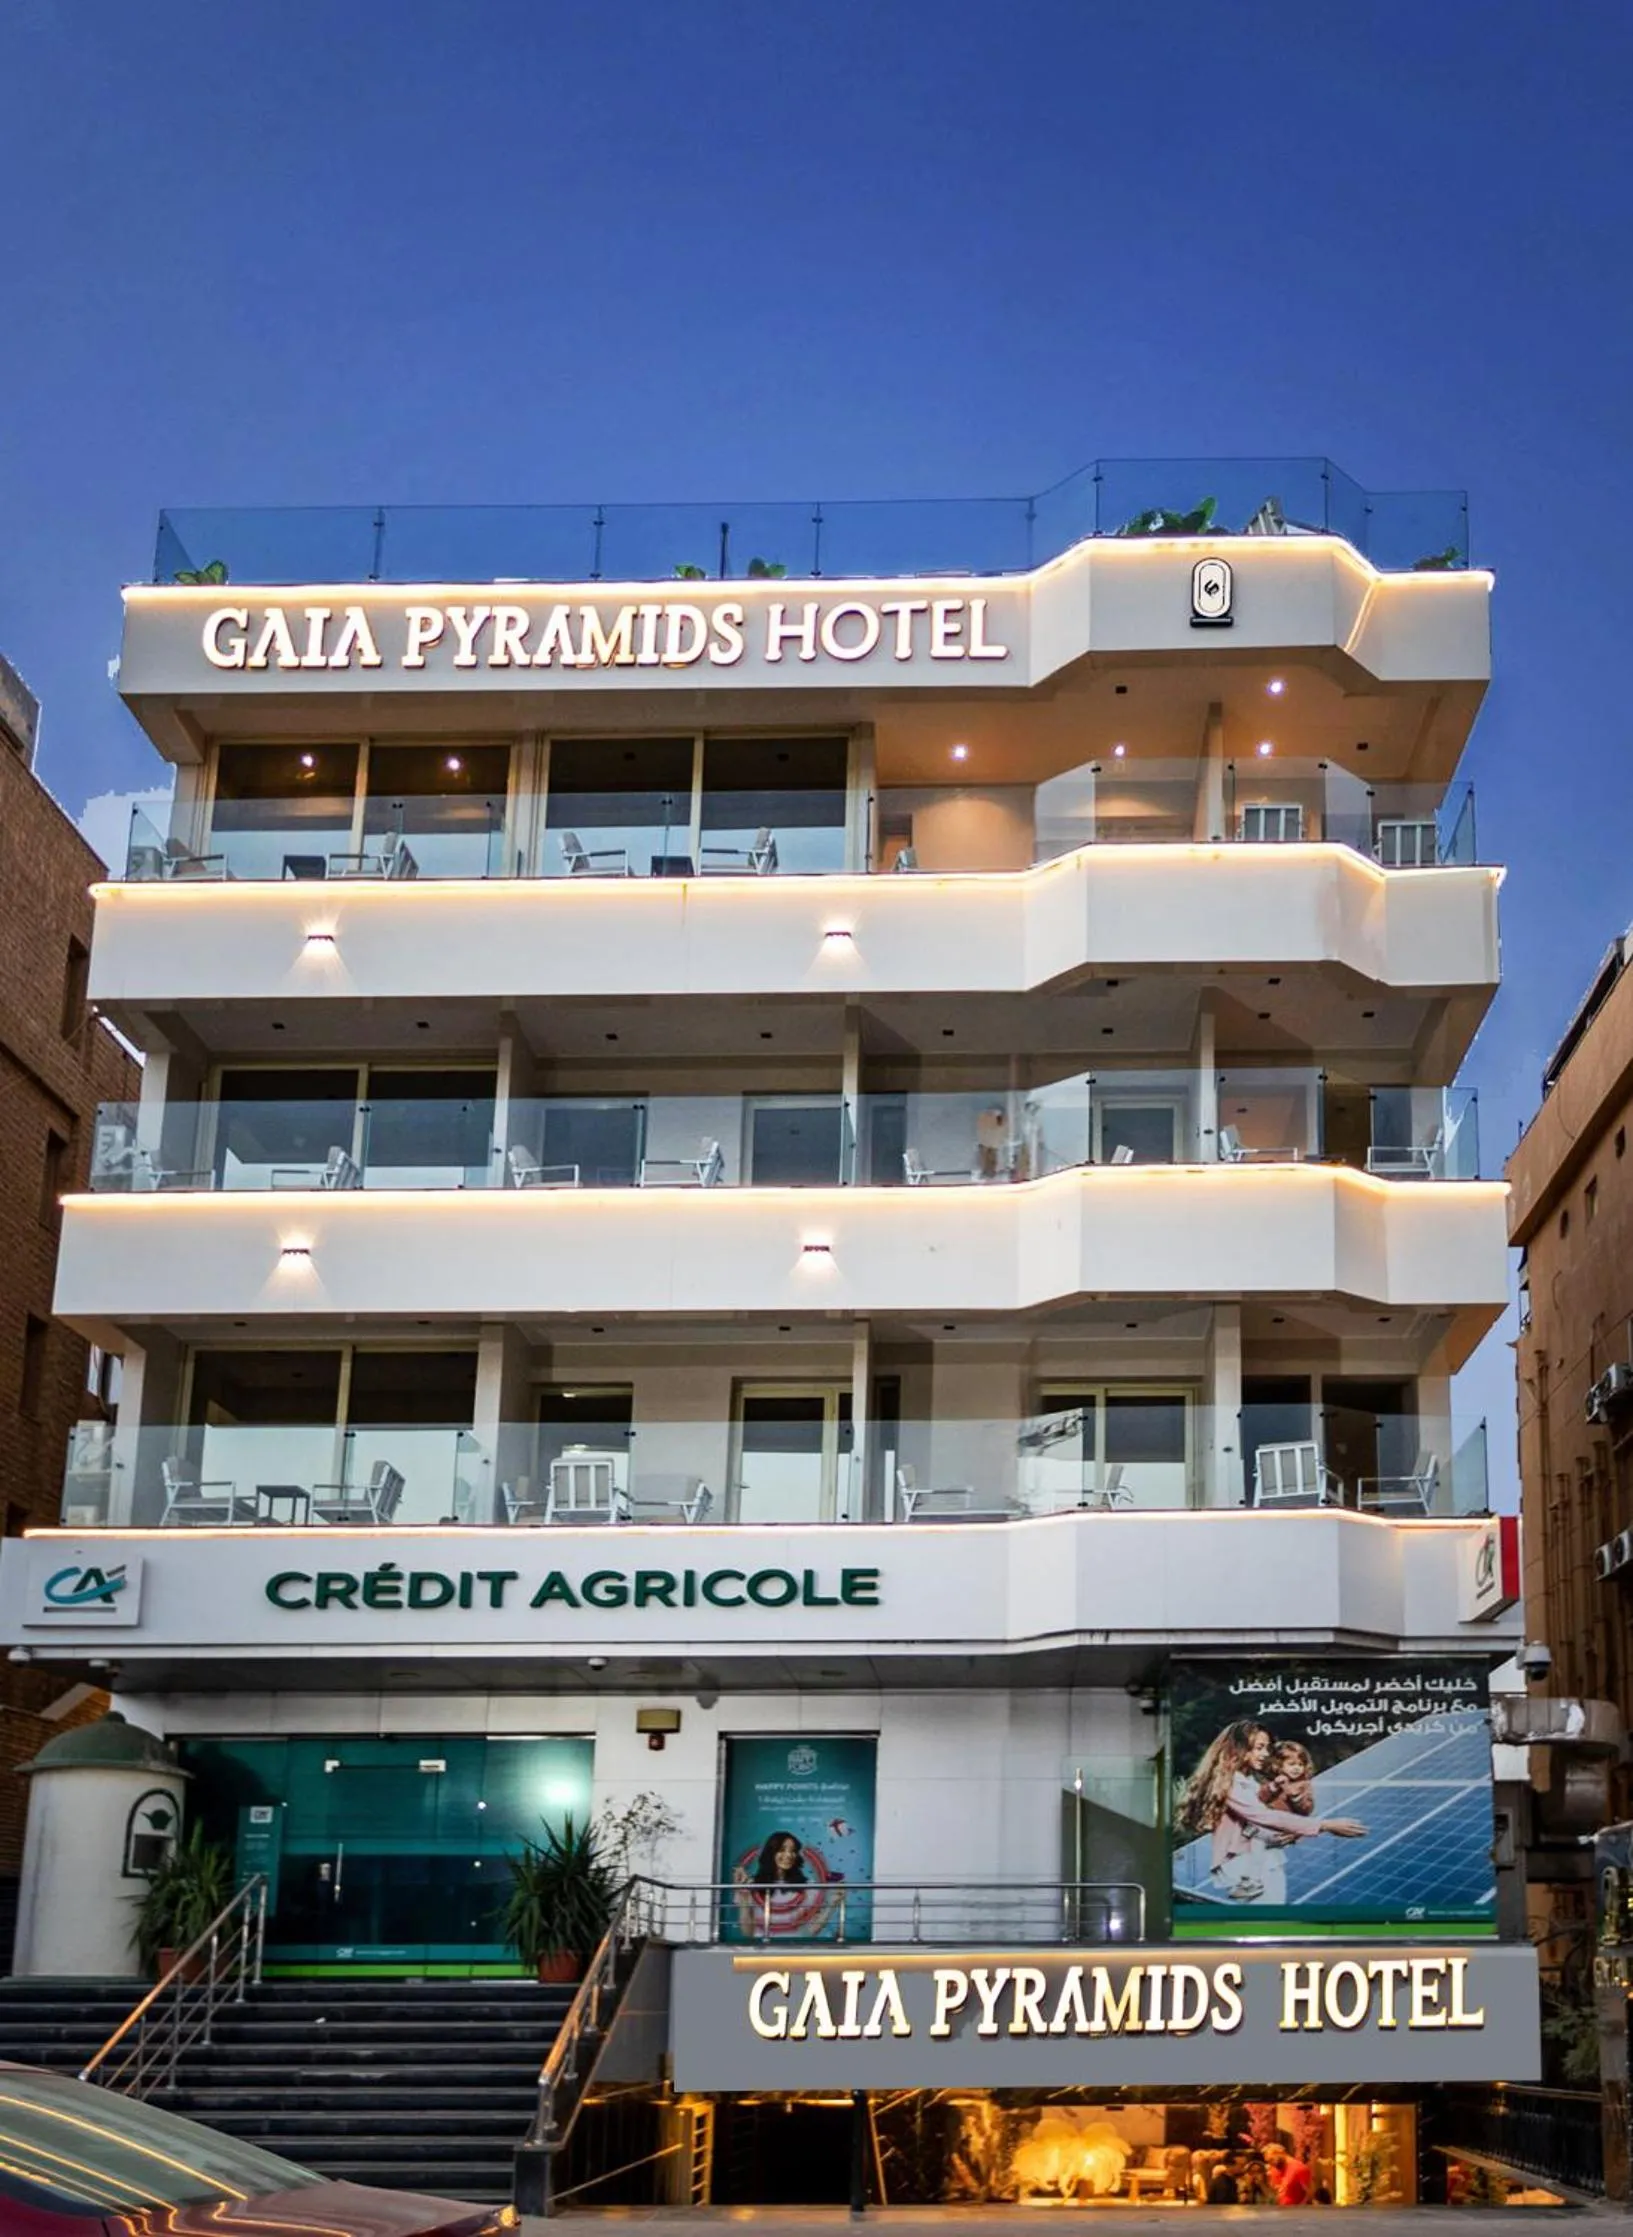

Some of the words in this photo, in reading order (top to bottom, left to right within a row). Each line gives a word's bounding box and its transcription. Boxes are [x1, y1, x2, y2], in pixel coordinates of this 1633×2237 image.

[201, 606, 383, 670] GAIA
[401, 601, 744, 670] PYRAMIDS
[763, 598, 1009, 663] HOTEL
[265, 1562, 518, 1611] CRÉDIT
[529, 1567, 881, 1610] AGRICOLE
[1228, 1674, 1282, 1695] أفضل
[1286, 1676, 1370, 1694] لمستقبل
[1373, 1674, 1422, 1694] أخضر
[1424, 1676, 1478, 1694] خليك
[1257, 1696, 1318, 1716] الأخضر
[1320, 1698, 1389, 1715] التمويل
[1392, 1698, 1447, 1714] برنامج
[748, 1968, 911, 2039] GAIA
[929, 1962, 1244, 2037] PYRAMIDS
[1278, 1957, 1486, 2031] HOTEL
